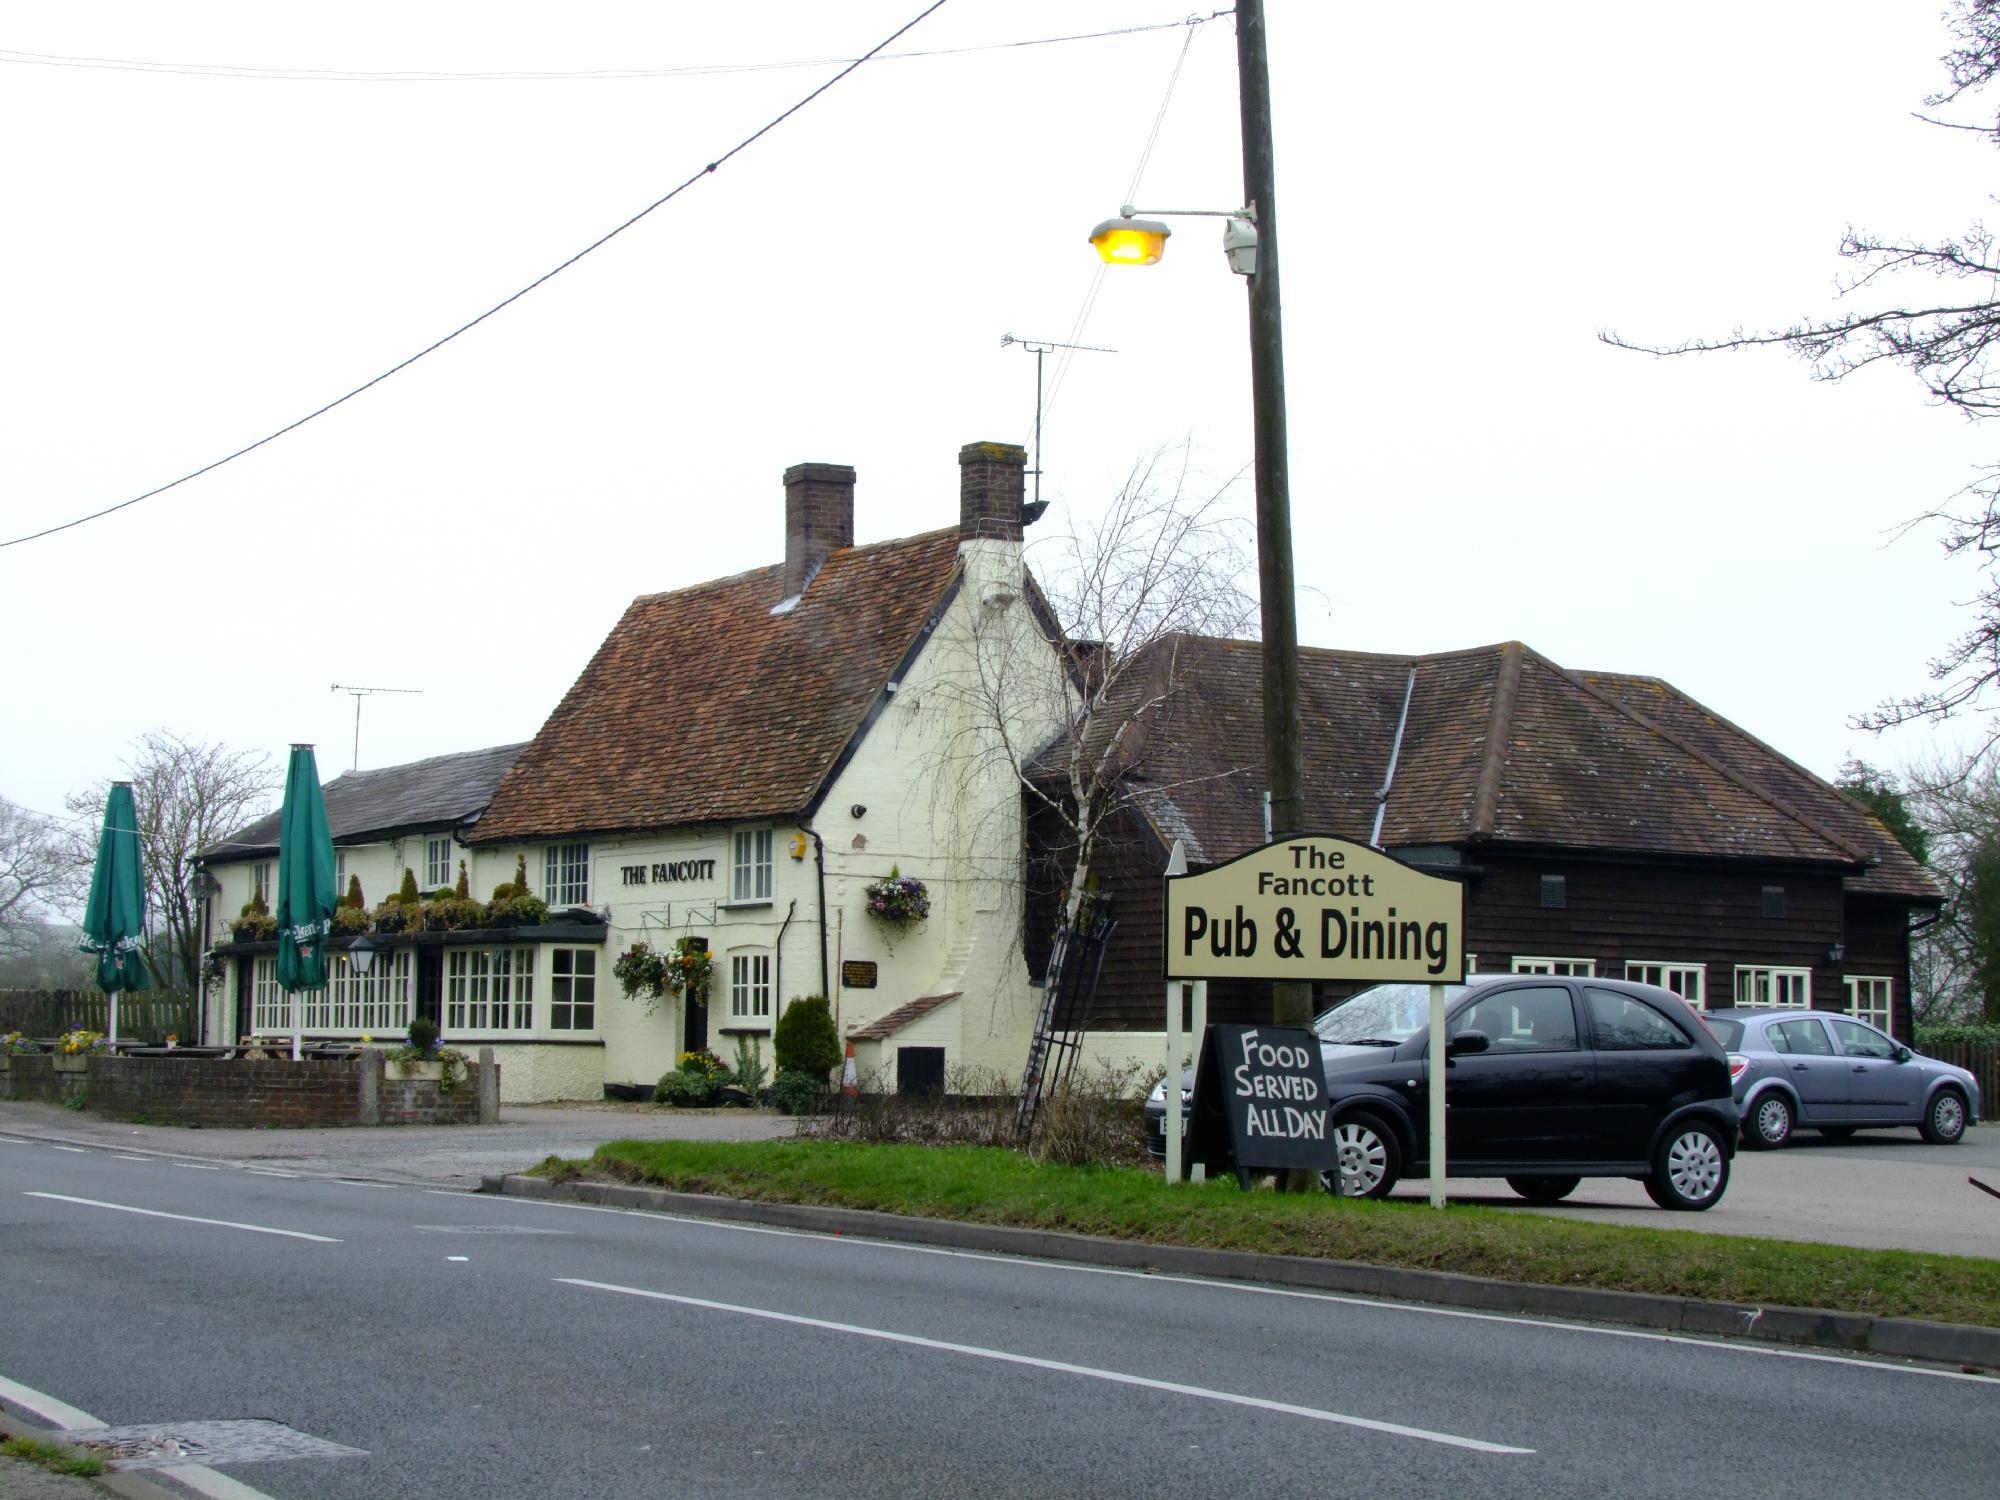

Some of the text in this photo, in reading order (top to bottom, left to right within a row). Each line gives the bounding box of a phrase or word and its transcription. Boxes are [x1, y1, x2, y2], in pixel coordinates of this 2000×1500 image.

[620, 859, 716, 885] THE FANCOTT
[1288, 845, 1345, 869] The
[1258, 872, 1374, 897] Fancott
[1184, 905, 1448, 975] Pub & Dining
[1241, 1029, 1310, 1069] FOOD
[1234, 1064, 1318, 1101] SERVED
